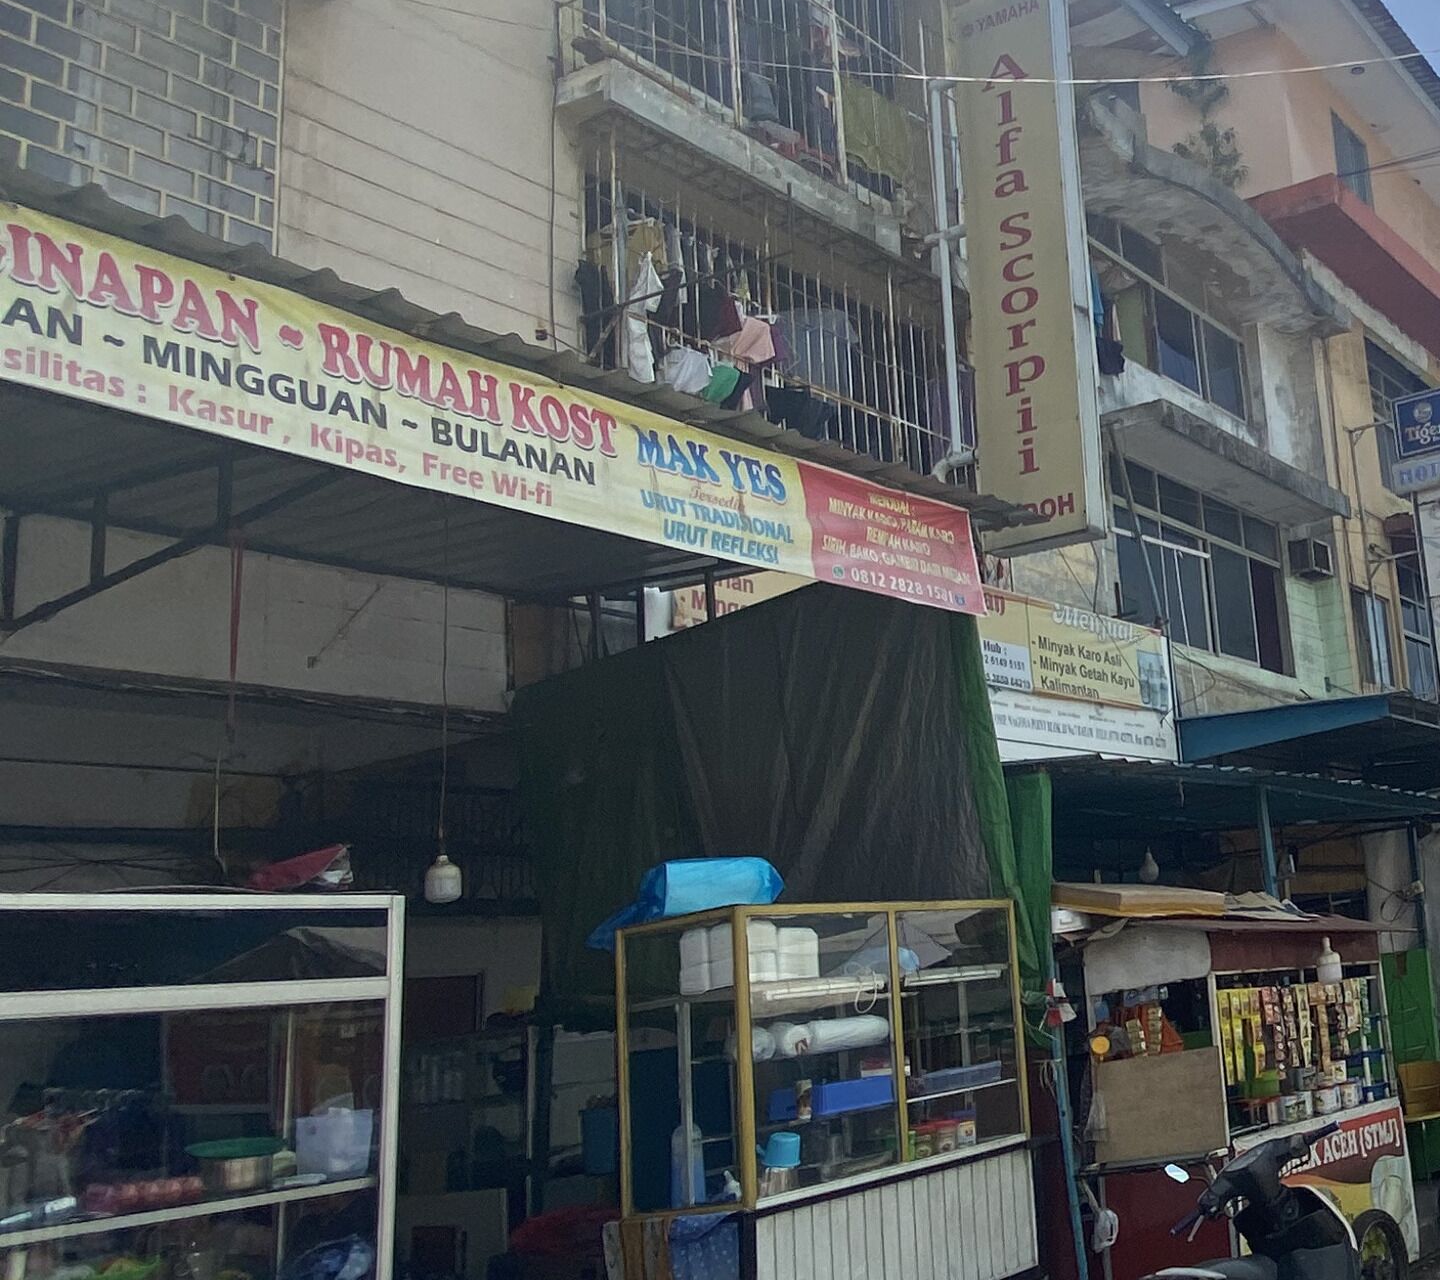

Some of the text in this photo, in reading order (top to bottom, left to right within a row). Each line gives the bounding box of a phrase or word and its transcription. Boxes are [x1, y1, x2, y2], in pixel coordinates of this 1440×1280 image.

[998, 210, 1046, 477] Scorpii
[0, 223, 263, 355] INAPAN
[317, 322, 503, 426] RUMAH
[509, 382, 618, 457] KOST
[637, 429, 722, 486] MAK
[719, 450, 788, 505] YES
[143, 334, 388, 430] MINGGUAN
[431, 417, 596, 486] BULANAN
[422, 452, 484, 489] Free
[491, 470, 553, 506] Wi-fi
[640, 489, 687, 517] URUT
[663, 518, 779, 564] URUT REFLEKSI
[851, 567, 886, 588] 0812
[1038, 635, 1076, 656] Minyak
[1078, 645, 1101, 663] Karo
[1040, 655, 1135, 690] Minyak Getah Kayu
[1040, 675, 1100, 699] Kalimantan
[1323, 1129, 1359, 1164] ACEH
